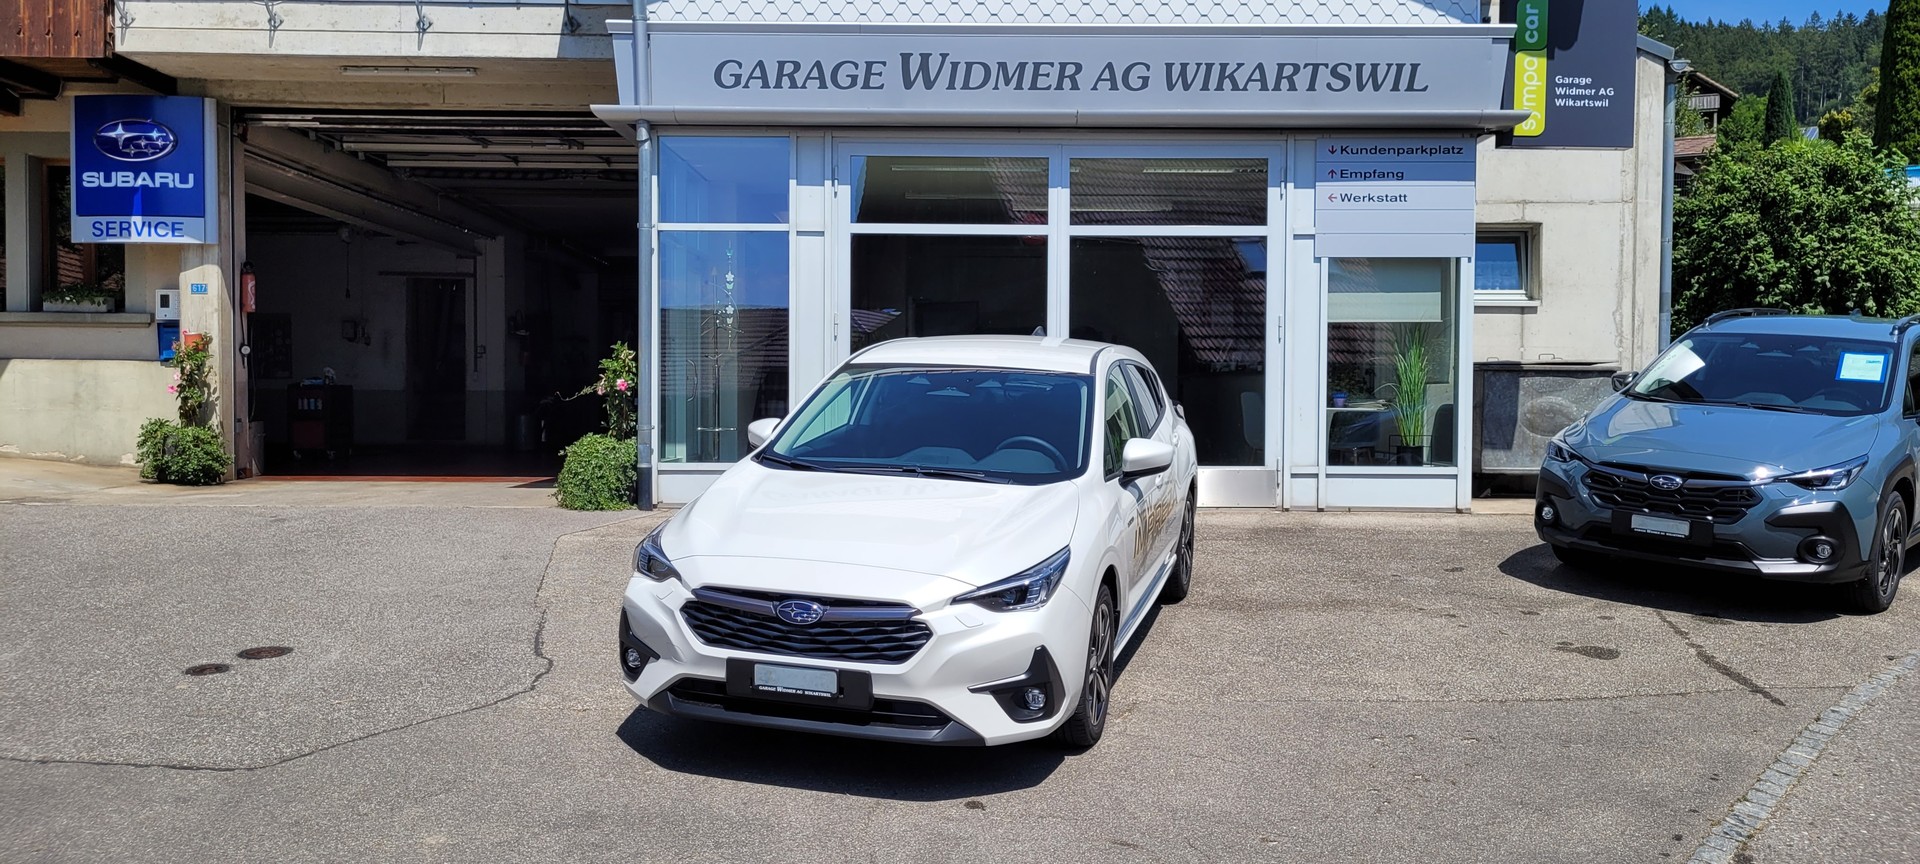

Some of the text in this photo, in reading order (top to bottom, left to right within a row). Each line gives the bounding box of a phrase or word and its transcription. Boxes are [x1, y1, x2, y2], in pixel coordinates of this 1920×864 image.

[1525, 3, 1539, 43] car
[713, 52, 1429, 92] GARAGE WIDMER AG WIKARTSWIL
[1555, 75, 1592, 86] Garage
[1555, 87, 1615, 96] Widmer AG
[1555, 98, 1609, 107] Wikartswil
[1340, 145, 1464, 157] Kundenparkplatz
[82, 171, 194, 189] SUBARU
[1340, 169, 1404, 181] Empfang
[1340, 193, 1408, 203] Werkstatt
[92, 220, 185, 238] SERVICE
[192, 284, 206, 292] 617
